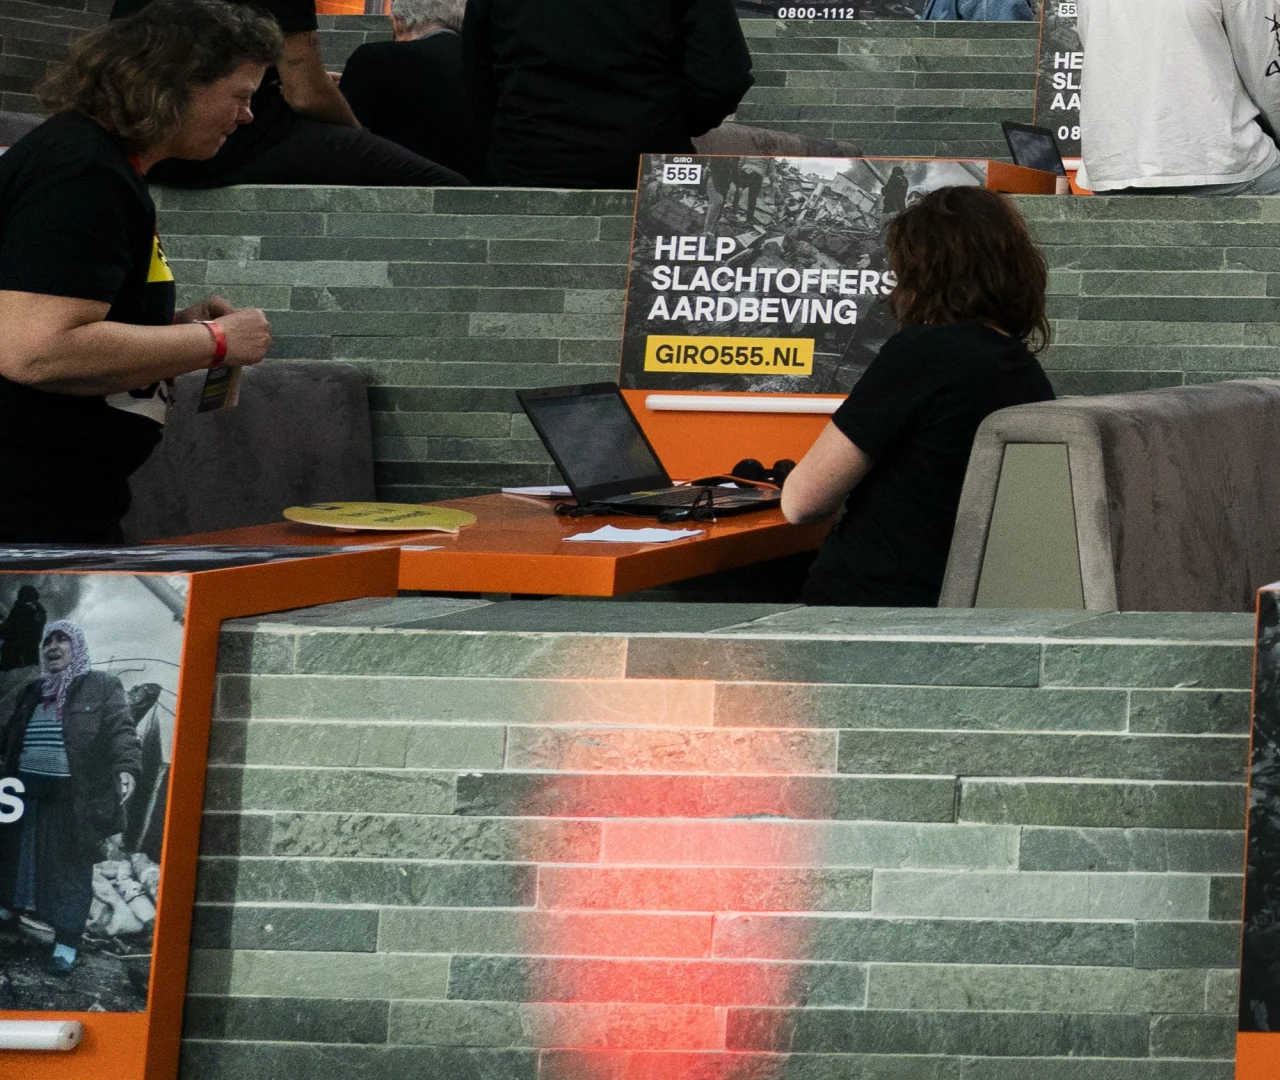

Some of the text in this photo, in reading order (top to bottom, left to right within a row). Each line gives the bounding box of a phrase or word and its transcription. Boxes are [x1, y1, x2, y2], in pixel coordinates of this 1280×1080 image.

[778, 7, 855, 19] 0800-1112
[1061, 5, 1076, 15] 55
[666, 166, 698, 181] 555
[654, 235, 736, 261] HELP
[651, 265, 899, 295] SLACHTOFFERS
[647, 295, 857, 325] AARDBEVING
[655, 344, 805, 367] GIRO555.NL
